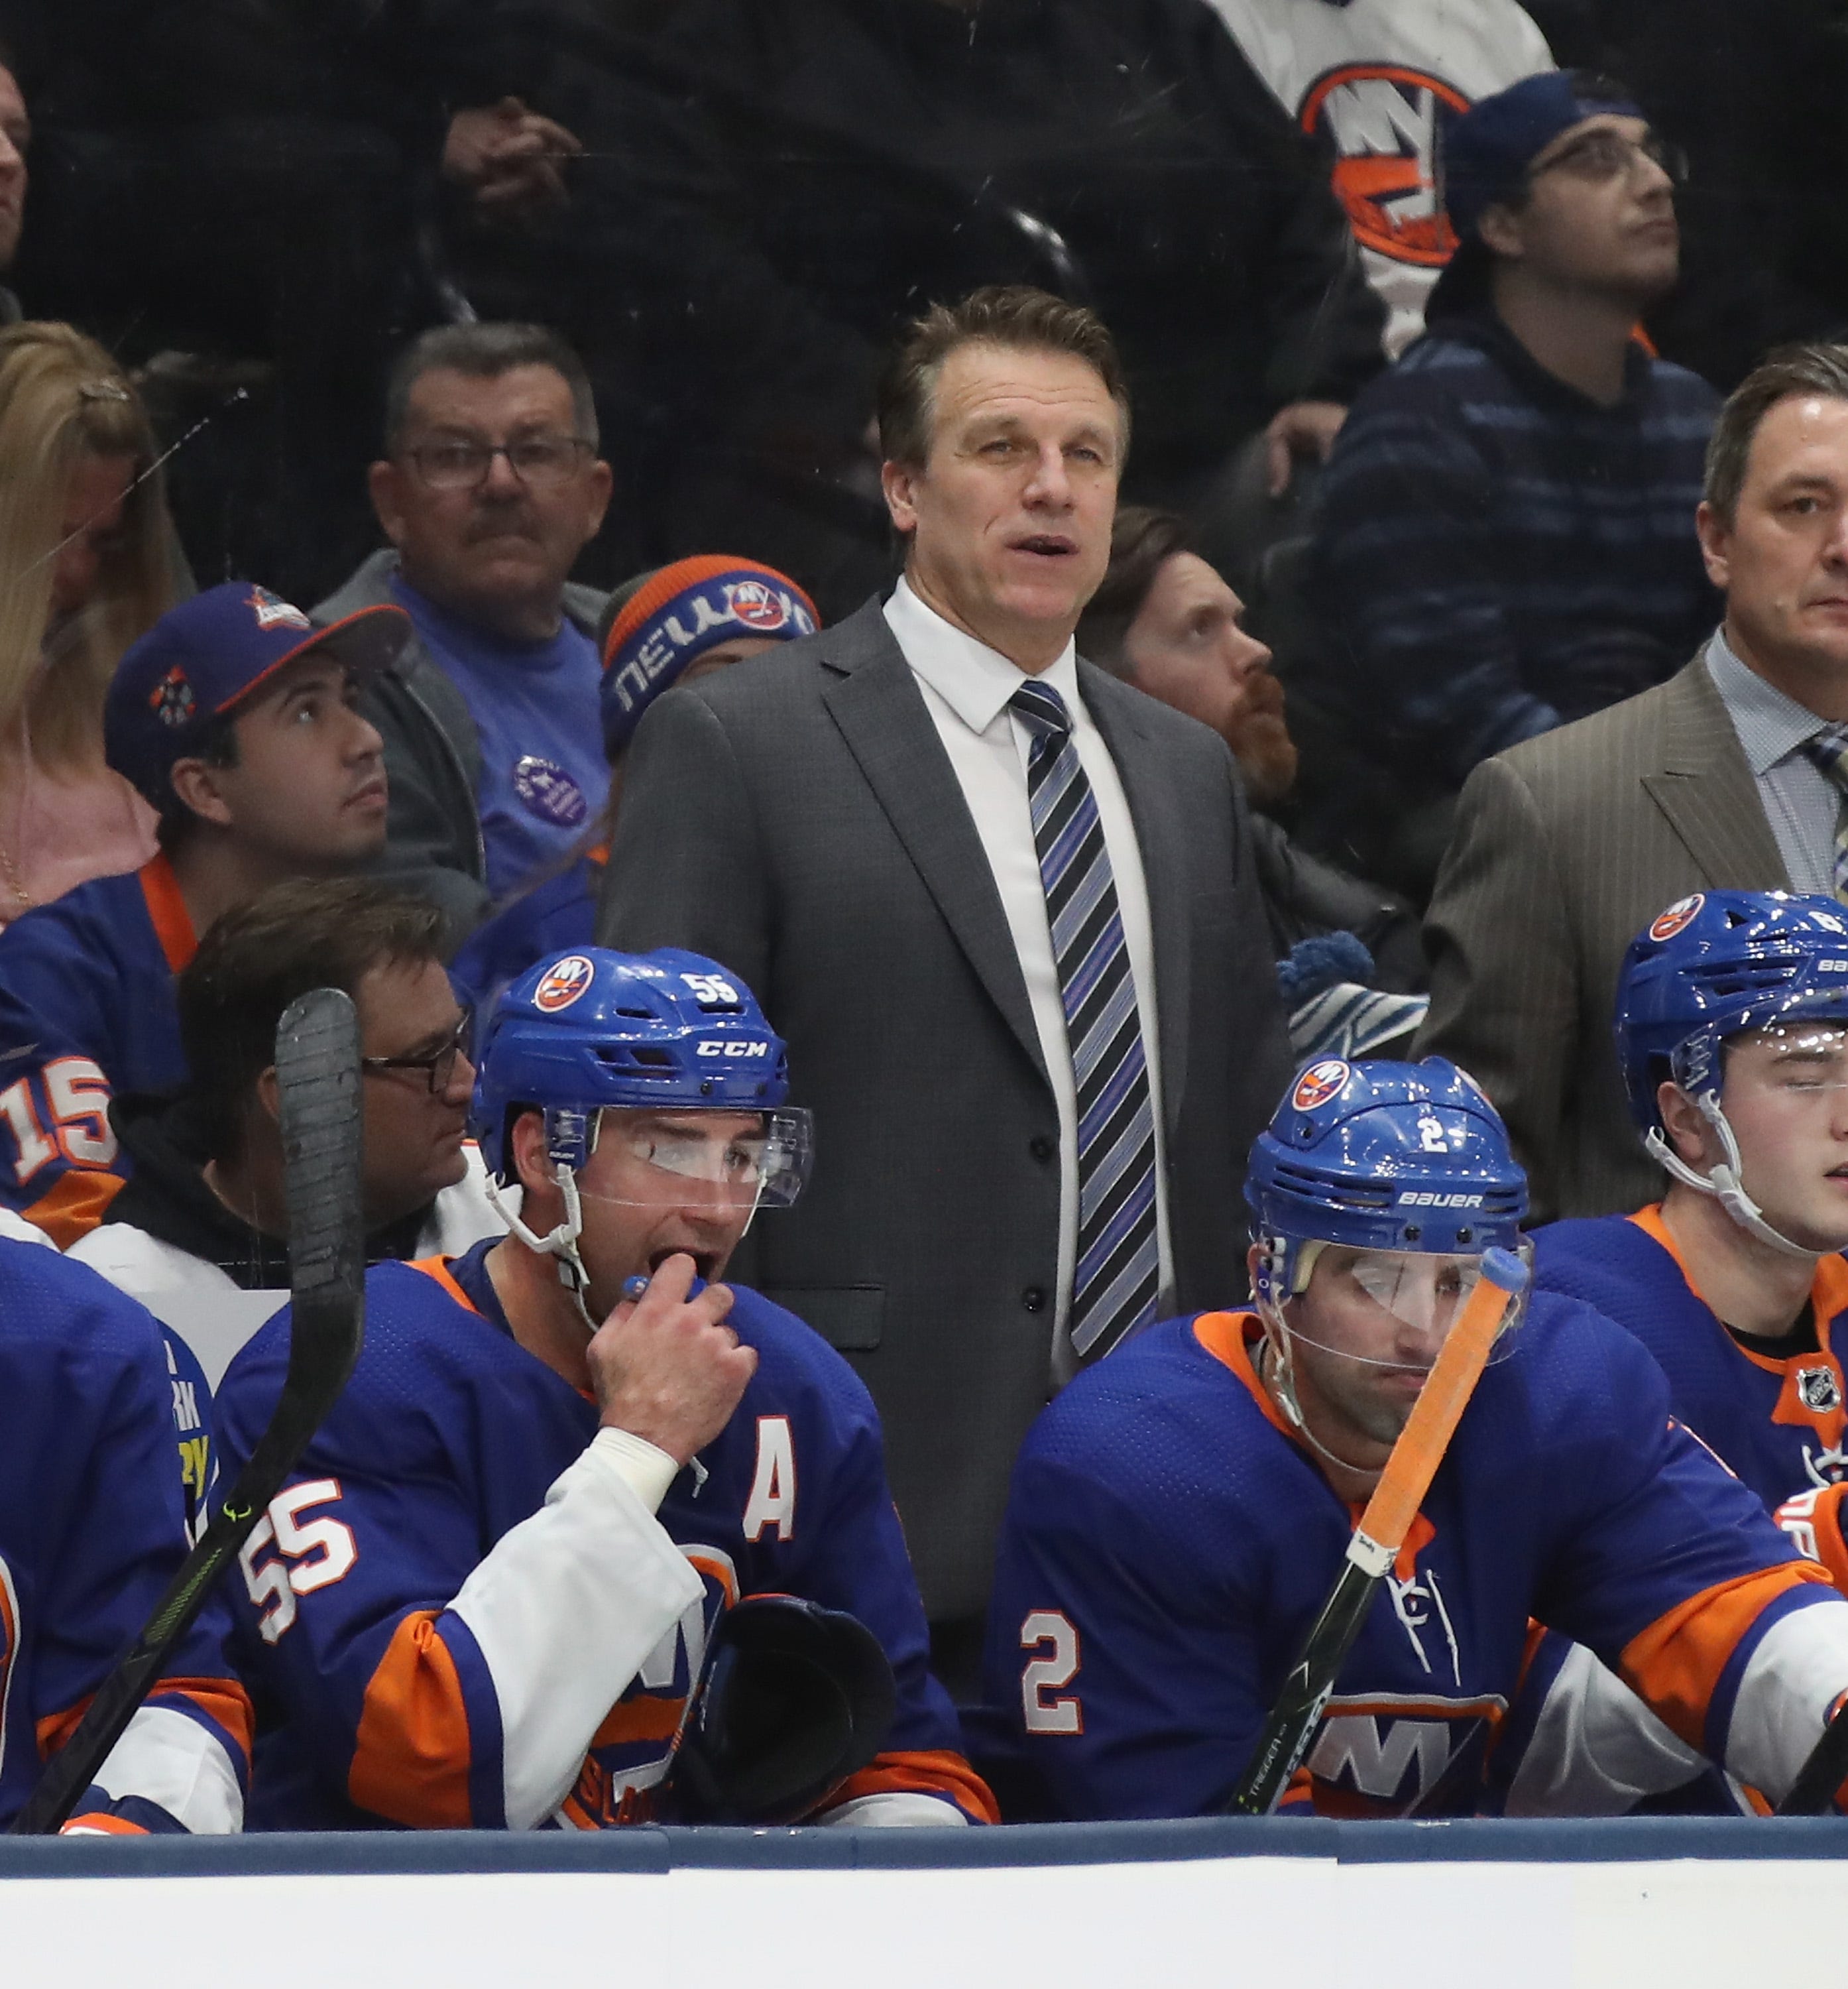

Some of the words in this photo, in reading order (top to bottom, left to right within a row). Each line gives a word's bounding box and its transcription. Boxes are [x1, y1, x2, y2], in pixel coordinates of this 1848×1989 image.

[679, 973, 738, 1004] 55
[697, 1041, 768, 1057] CCM
[0, 1055, 119, 1185] 15
[1416, 1116, 1448, 1153] 2
[1398, 1191, 1483, 1209] BAUER
[742, 1414, 797, 1543] A
[239, 1477, 358, 1645] 55
[1019, 1608, 1084, 1735] 2
